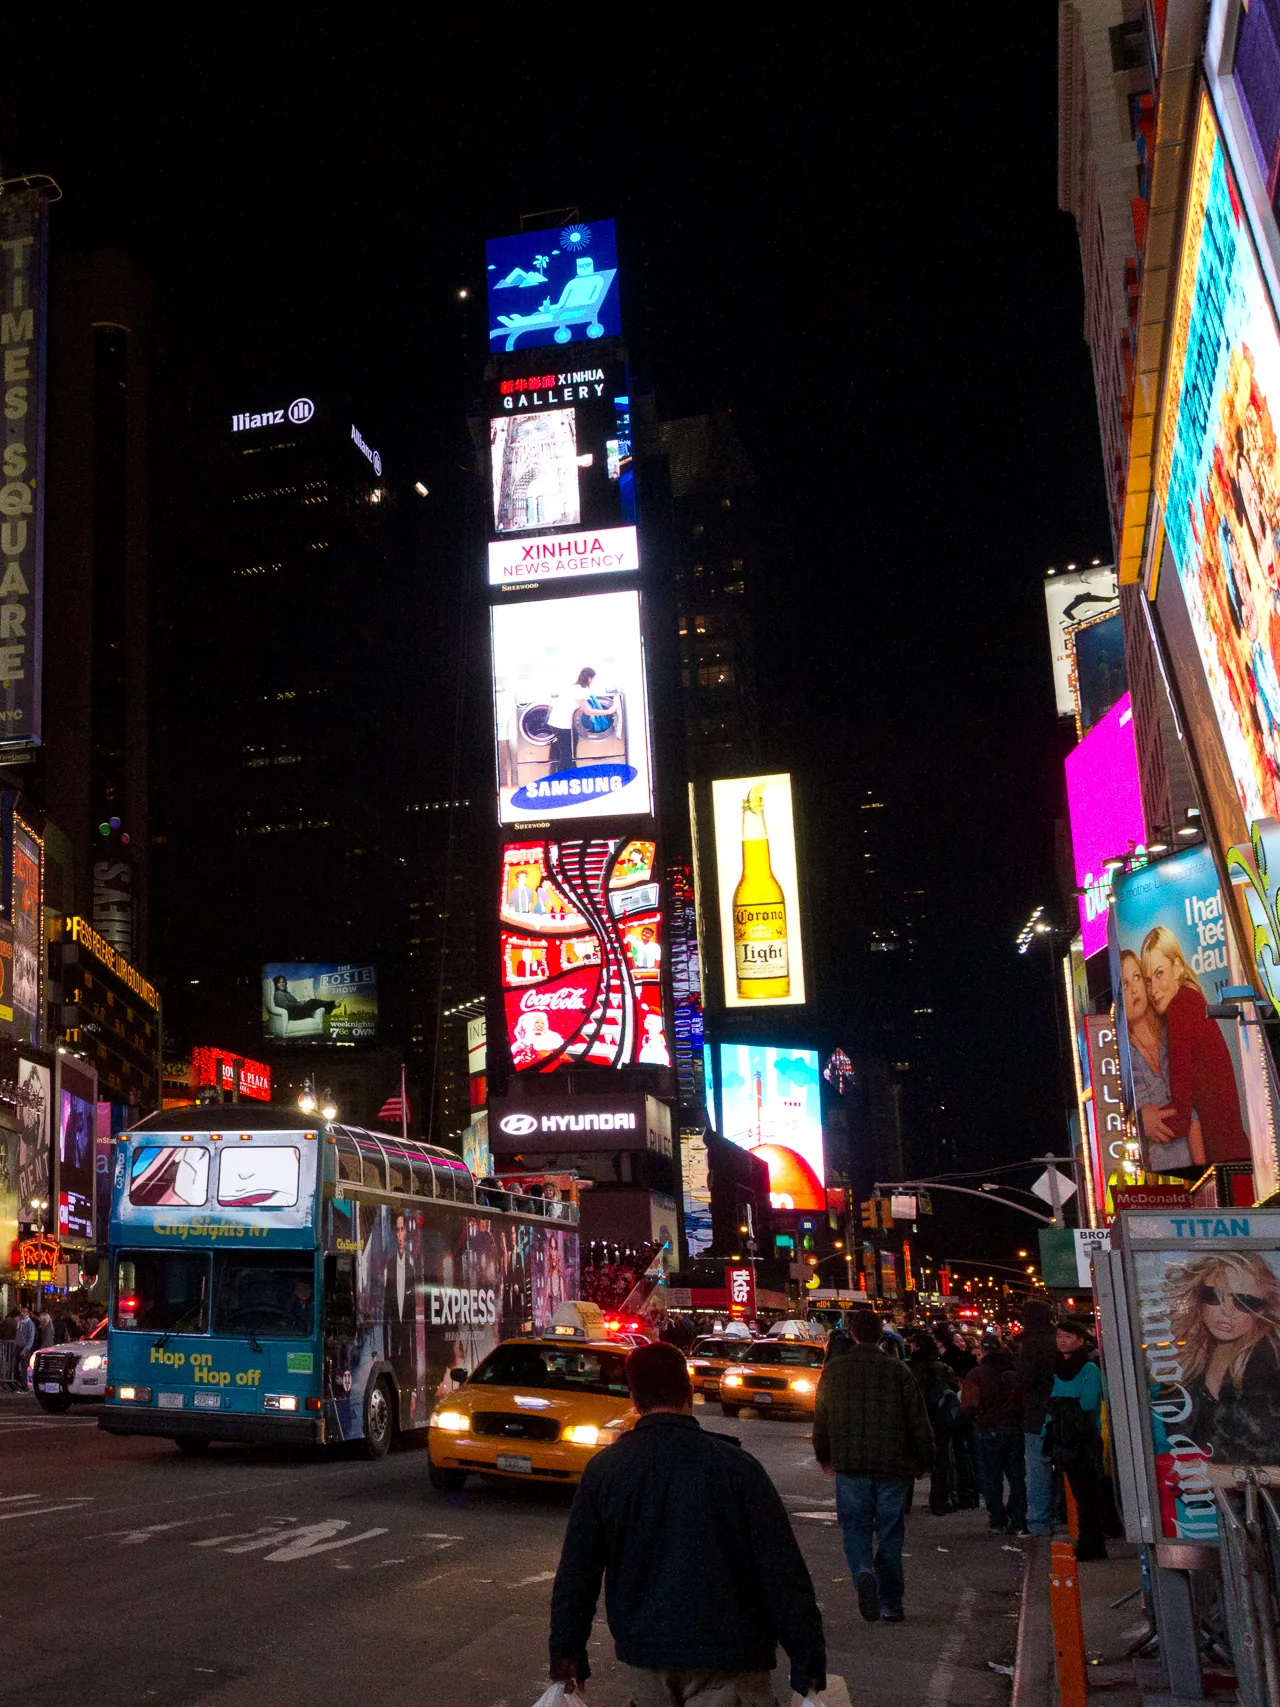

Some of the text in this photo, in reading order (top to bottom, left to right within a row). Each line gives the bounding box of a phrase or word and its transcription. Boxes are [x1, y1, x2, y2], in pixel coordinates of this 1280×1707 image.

[0, 236, 35, 420] TIMES
[558, 368, 605, 386] XINHUA
[503, 383, 605, 410] GALLERY
[231, 406, 285, 433] llianz
[350, 424, 374, 464] Allianz
[521, 537, 604, 561] XINHUA
[503, 553, 625, 578] NEWS AGENCY
[501, 582, 540, 593] SHERWOOD
[525, 775, 623, 799] SAMSUNG
[514, 821, 551, 831] SHERWOOD
[736, 905, 785, 925] Corona
[1192, 889, 1223, 924] hat
[741, 943, 783, 964] Light
[321, 969, 371, 987] ROSIE
[337, 964, 351, 972] THE
[331, 985, 357, 994] SHOW
[520, 988, 587, 1013] Coca-Cola
[352, 1027, 375, 1037] OWN
[247, 1072, 269, 1089] PLAZA
[1098, 1029, 1124, 1159] PALAC
[541, 1112, 637, 1132] HYUNDAI
[1116, 1193, 1194, 1204] McDonald's
[1169, 1218, 1251, 1238] TITAN
[24, 1246, 57, 1266] ROXY
[732, 1268, 752, 1304] tkts
[430, 1287, 497, 1326] EXPRESS
[554, 1325, 576, 1336] 2N30
[150, 1347, 213, 1368] Hop on
[194, 1366, 263, 1387] Hop off
